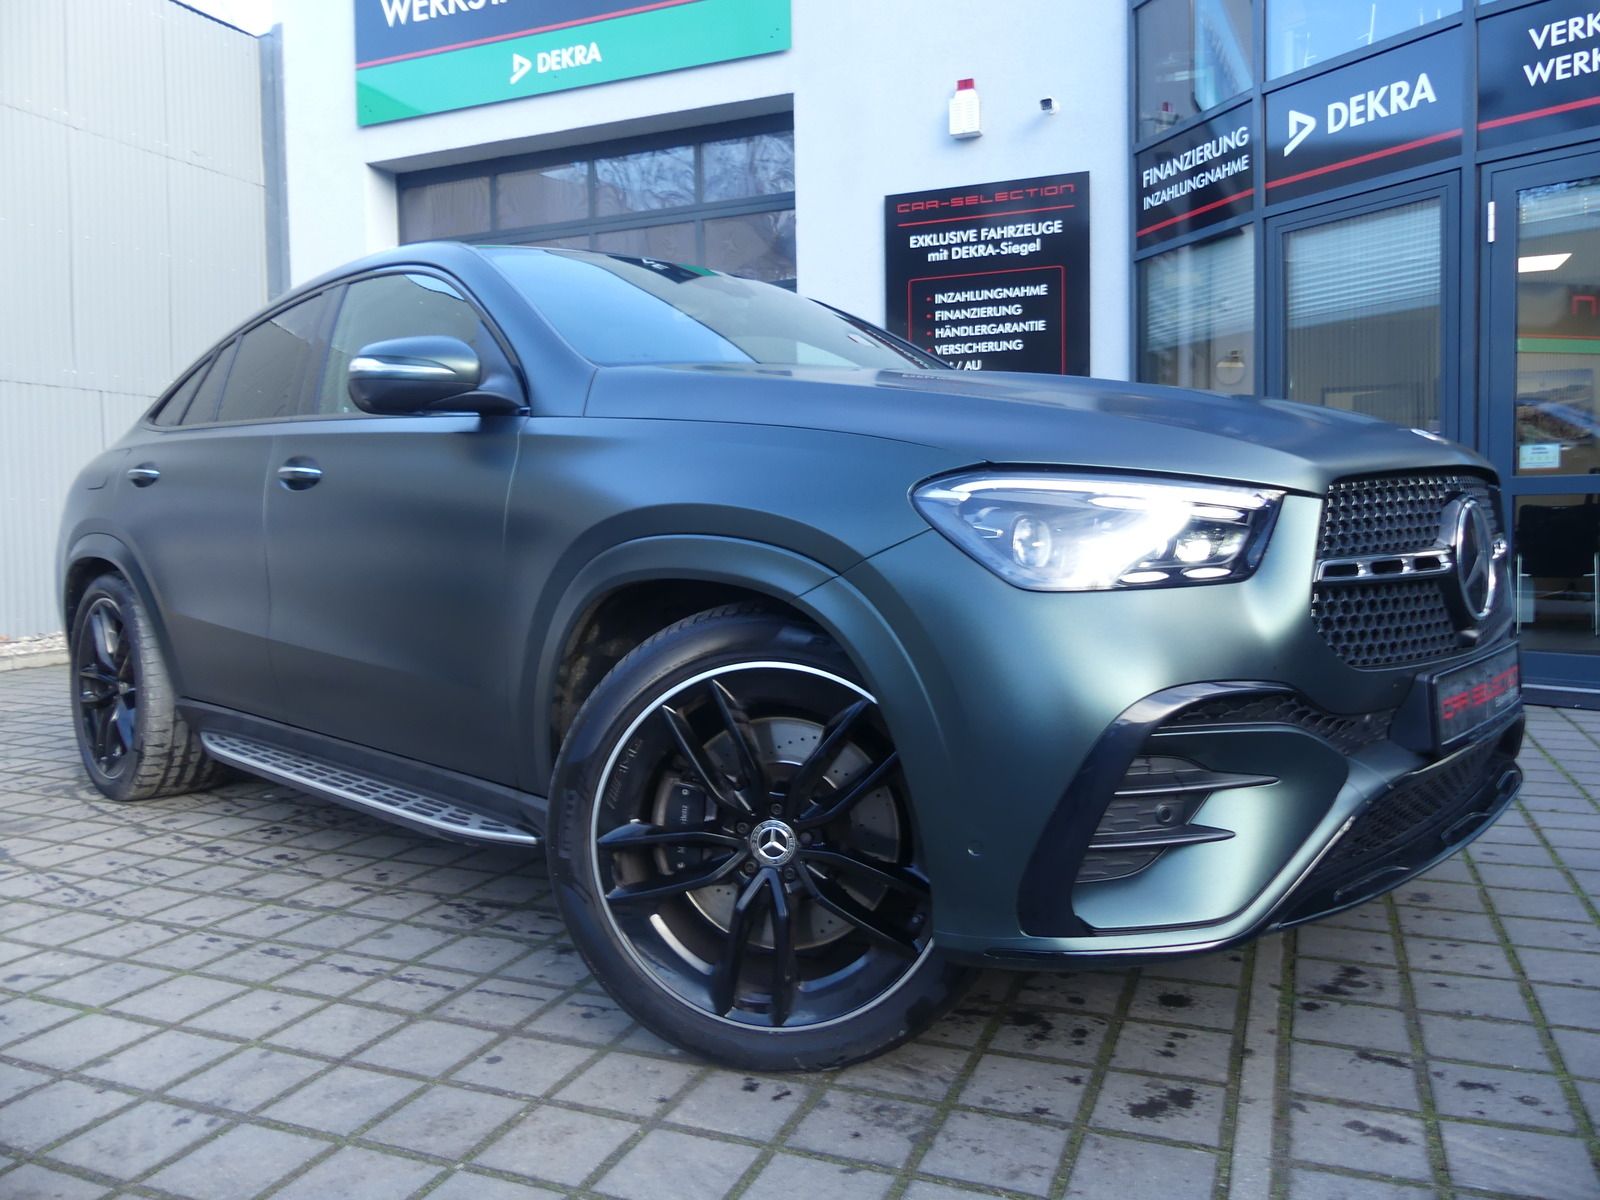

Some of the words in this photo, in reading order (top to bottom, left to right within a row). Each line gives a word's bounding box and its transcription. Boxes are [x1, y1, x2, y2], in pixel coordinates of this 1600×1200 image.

[537, 42, 602, 73] DEKRA
[1327, 72, 1437, 135] DEKRA
[1142, 125, 1250, 189] FINANZIERUNG
[1143, 154, 1250, 211] INZAHLUNGNAHME
[897, 184, 1075, 213] CAR-SELECTION
[908, 229, 978, 250] EXKLUSIVE
[980, 220, 1063, 241] FAHRZEUGE
[927, 248, 949, 262] mit
[951, 238, 1042, 261] DEKRA-Siegel
[934, 284, 1048, 304] INZAHLUNGNAHME
[934, 303, 1023, 322] FINANZIERUNG
[934, 319, 1047, 339] HÄNDLERGARANTIE
[934, 339, 1024, 355] VERSICHERUNG
[963, 359, 982, 371] AU
